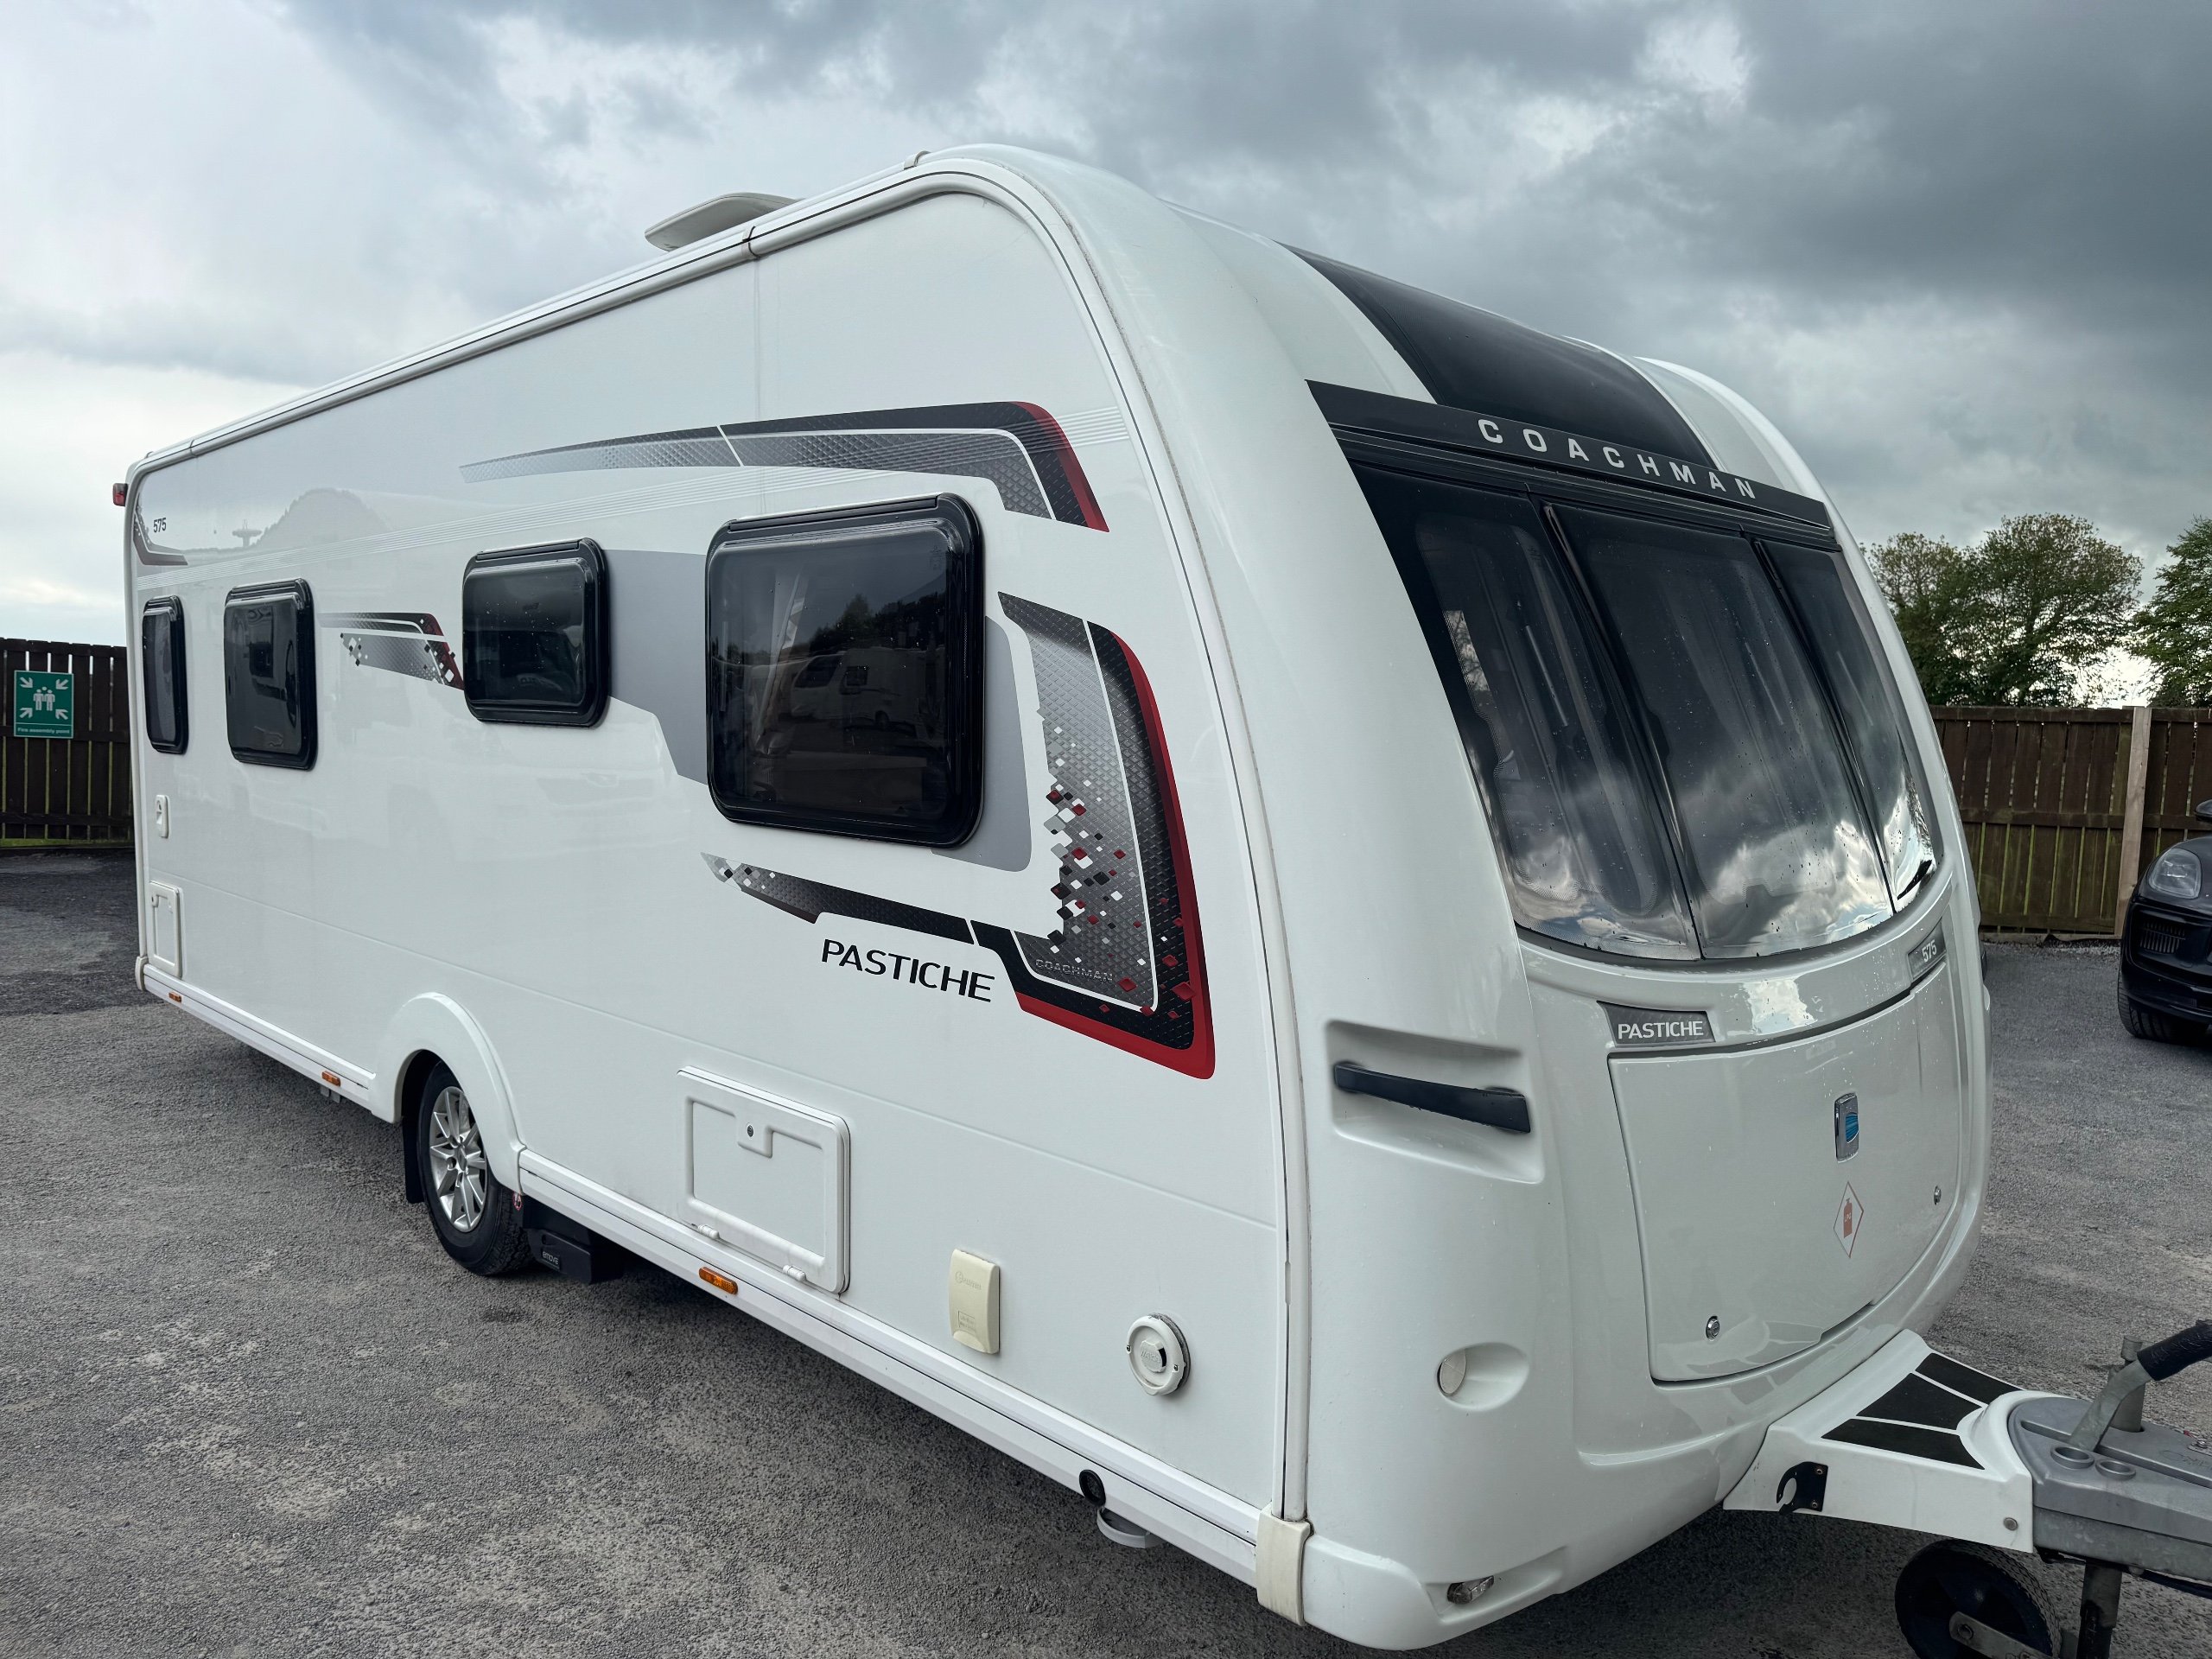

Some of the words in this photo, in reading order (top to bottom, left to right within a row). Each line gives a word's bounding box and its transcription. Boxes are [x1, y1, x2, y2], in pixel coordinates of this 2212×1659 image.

[1478, 418, 1757, 499] COACHMAN
[153, 517, 167, 533] 575
[1921, 939, 1937, 963] 575
[821, 938, 995, 1003] PASTICHE
[1035, 958, 1114, 983] COACHMAN
[1618, 1020, 1705, 1039] PASTICHE
